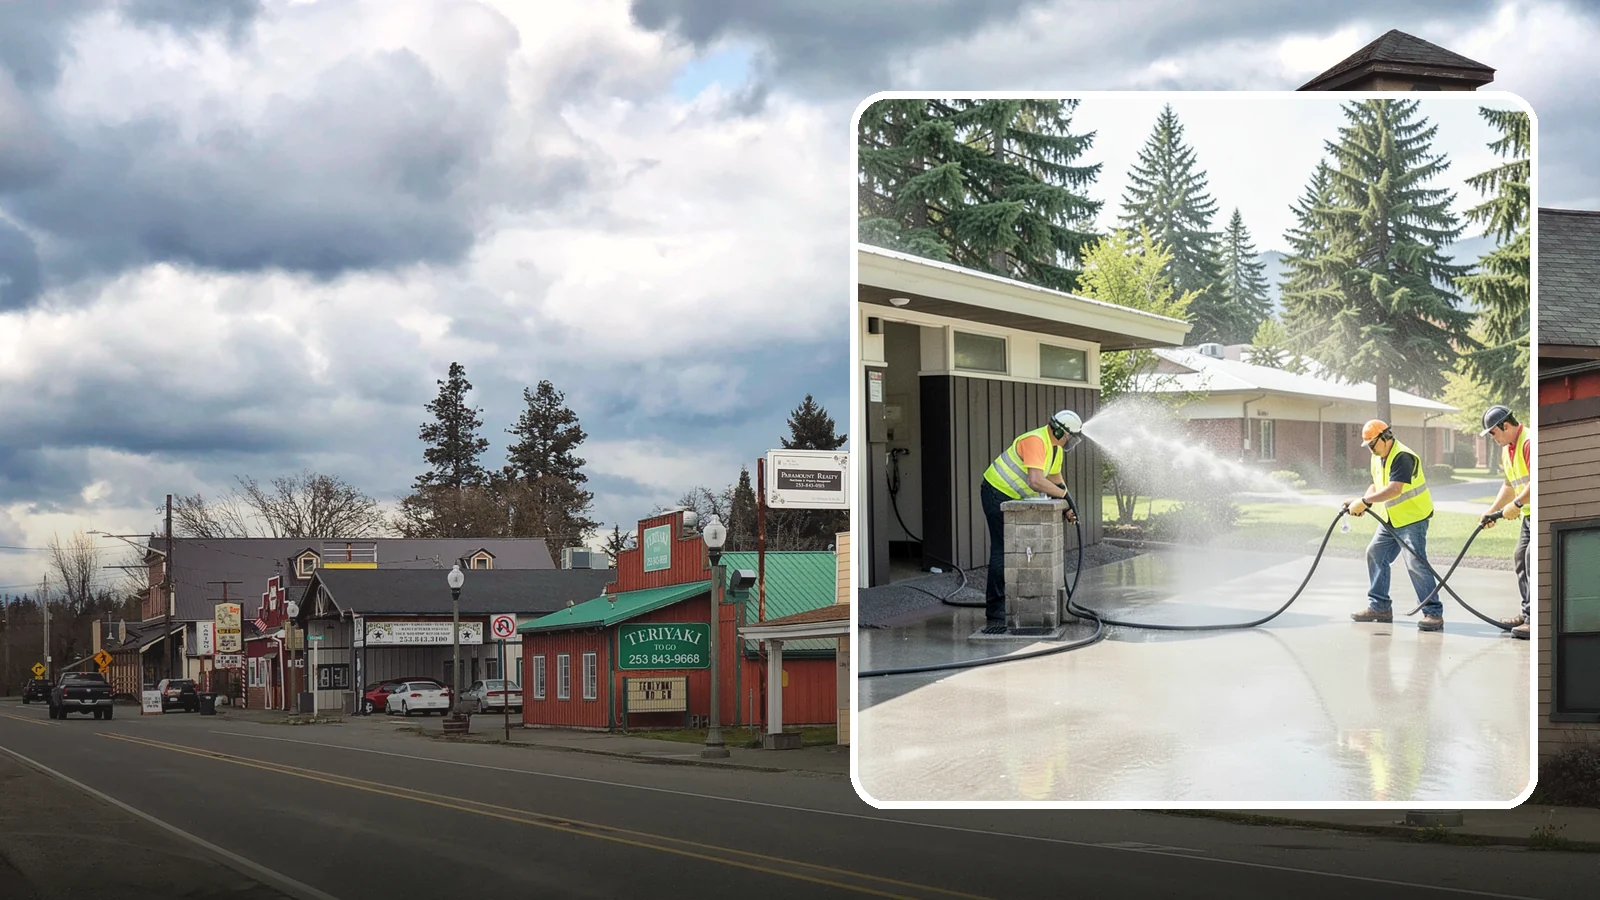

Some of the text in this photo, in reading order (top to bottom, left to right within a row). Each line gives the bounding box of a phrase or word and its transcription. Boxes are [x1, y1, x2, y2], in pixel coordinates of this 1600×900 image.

[781, 471, 839, 480] PARAMOUNT REALTY
[624, 627, 703, 646] TERIYAKI
[629, 653, 700, 665] 253 843-9668
